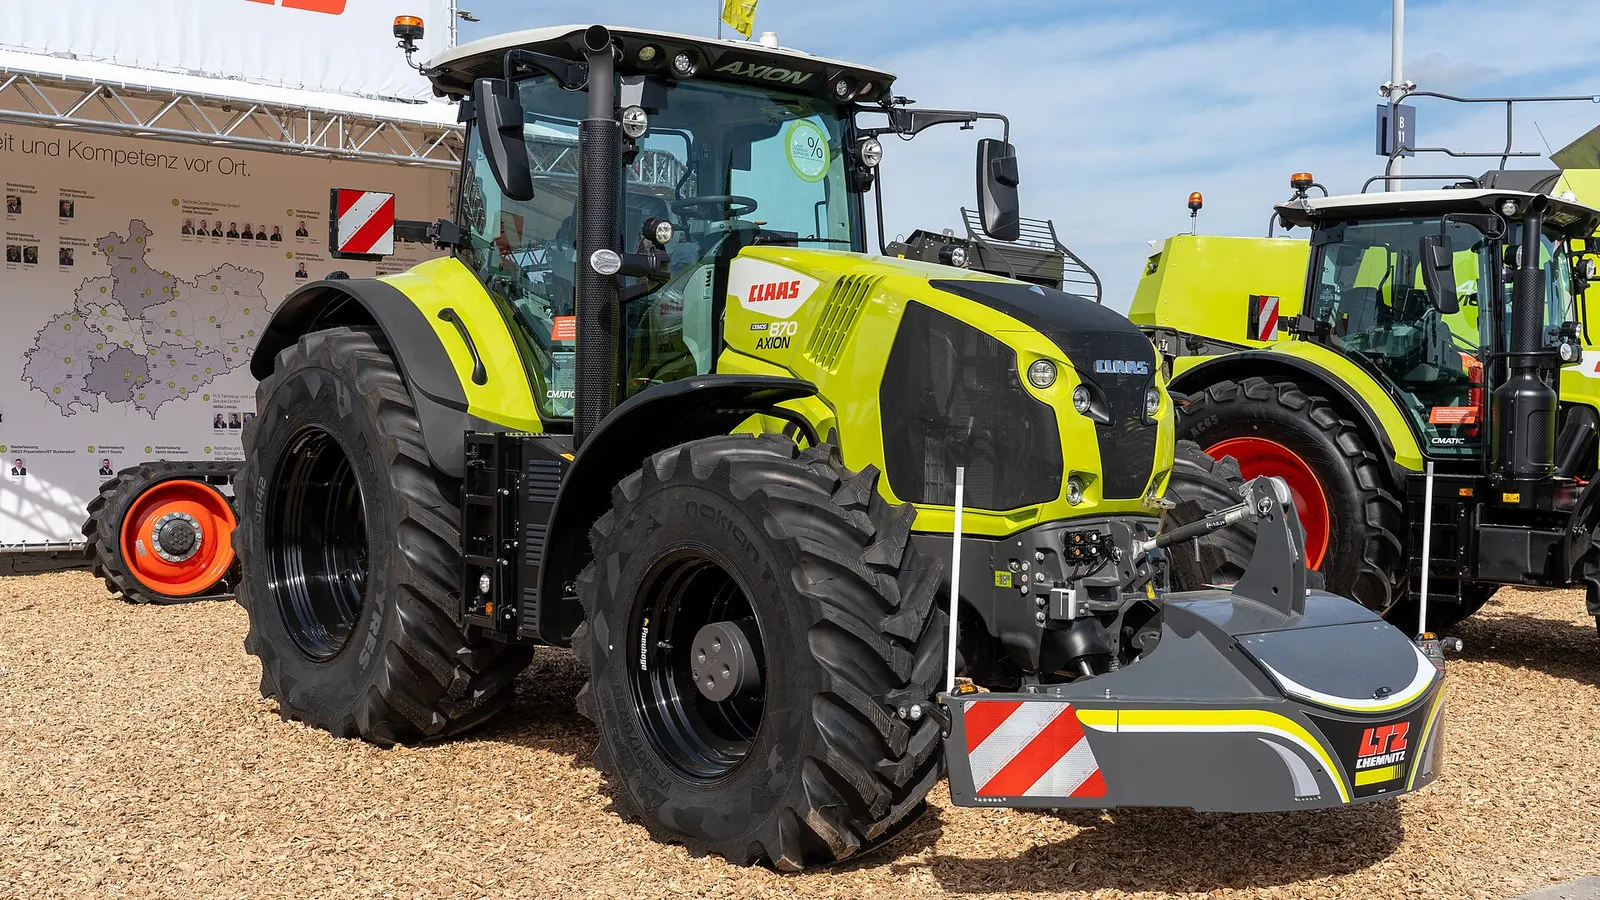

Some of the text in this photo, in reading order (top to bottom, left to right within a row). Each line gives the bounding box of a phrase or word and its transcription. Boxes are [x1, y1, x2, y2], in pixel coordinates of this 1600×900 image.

[715, 61, 814, 84] AXION
[1399, 116, 1405, 128] B
[1398, 131, 1405, 142] 11
[22, 139, 60, 156] und
[68, 140, 178, 170] Kompetenz
[184, 155, 212, 174] vor
[218, 157, 251, 177] Ort.
[748, 280, 800, 302] CLAAS
[768, 322, 798, 337] 870
[756, 336, 790, 350] AXION
[1094, 359, 1148, 375] CLAAS
[640, 627, 649, 671] Pneuhage
[1358, 721, 1410, 758] LTZ
[1356, 751, 1406, 769] CHEMNITZ
